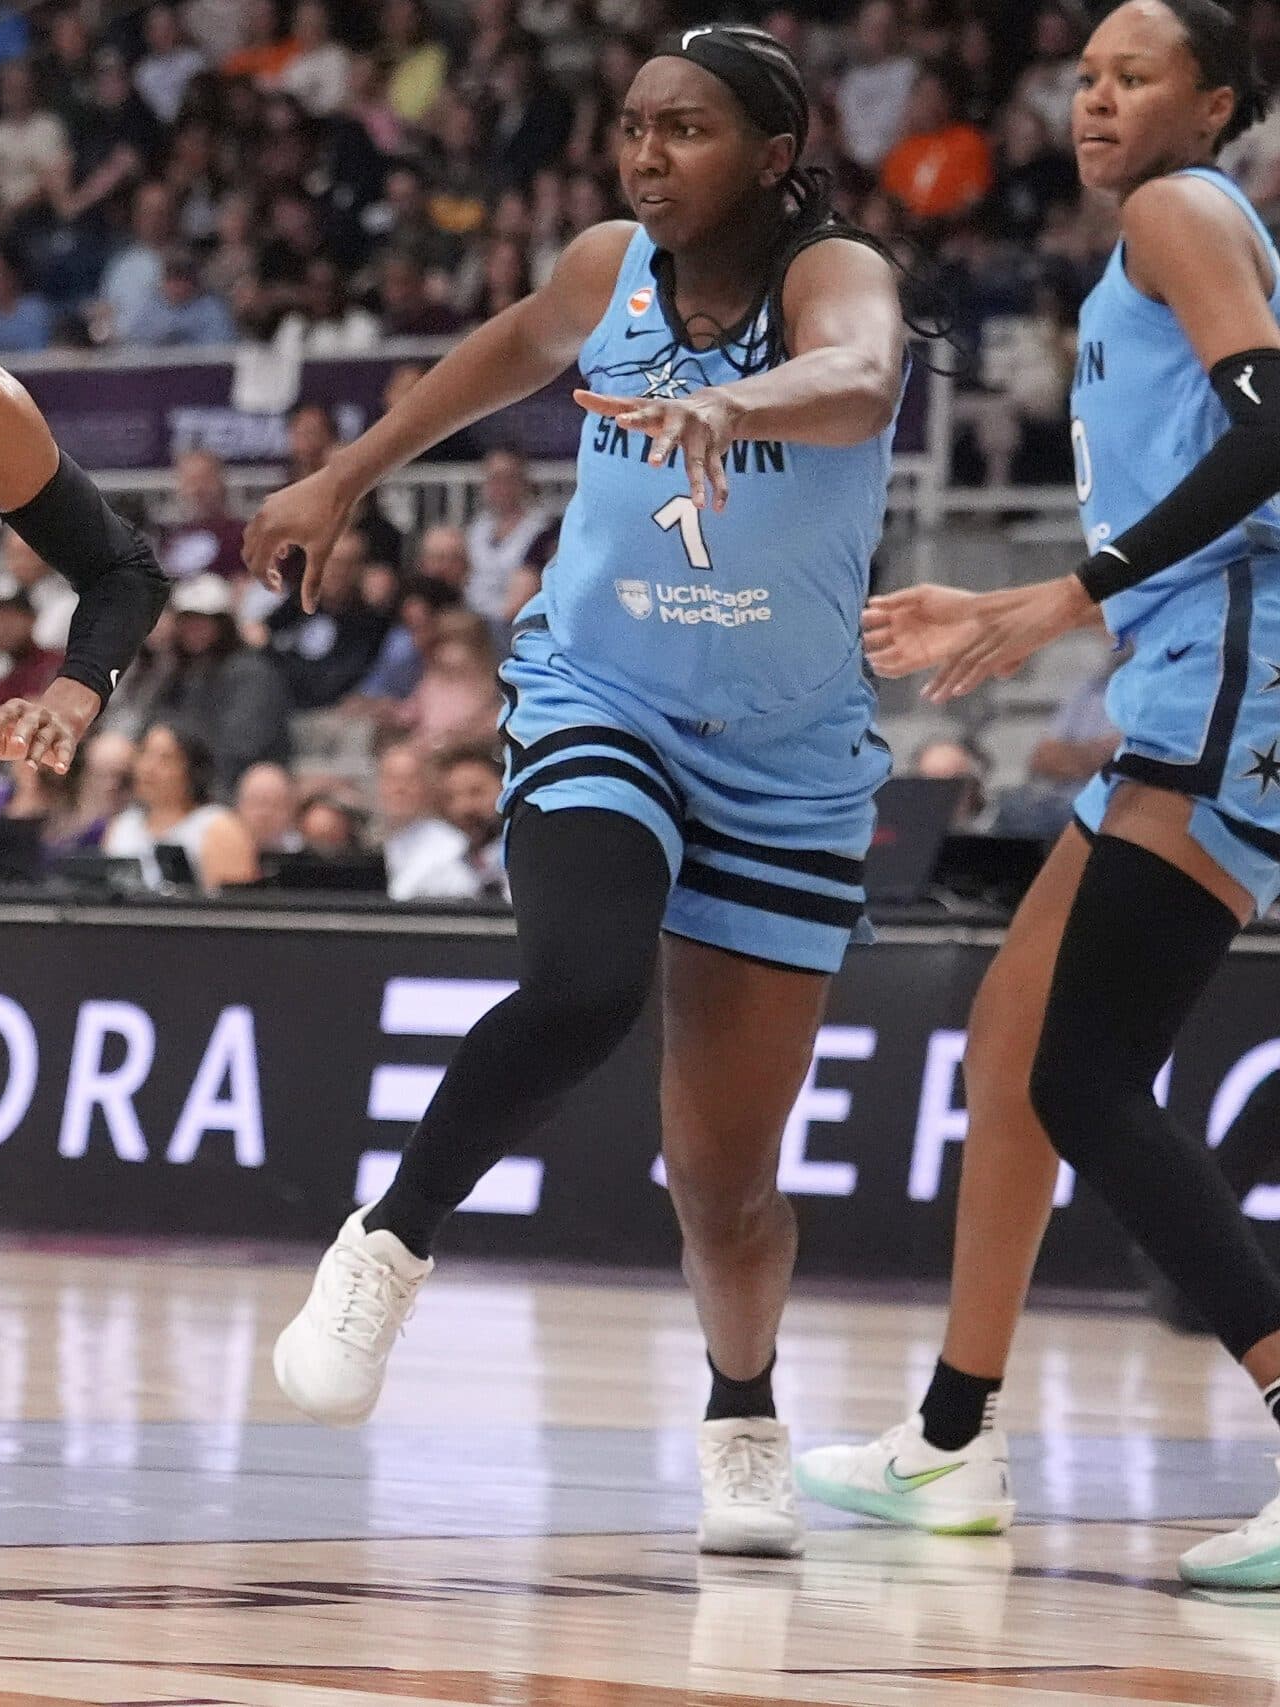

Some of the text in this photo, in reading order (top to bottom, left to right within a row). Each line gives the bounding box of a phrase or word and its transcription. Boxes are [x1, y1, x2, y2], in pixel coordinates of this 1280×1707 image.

[651, 495, 713, 571] 1
[655, 583, 769, 609] UChicago
[659, 604, 771, 628] Medicine
